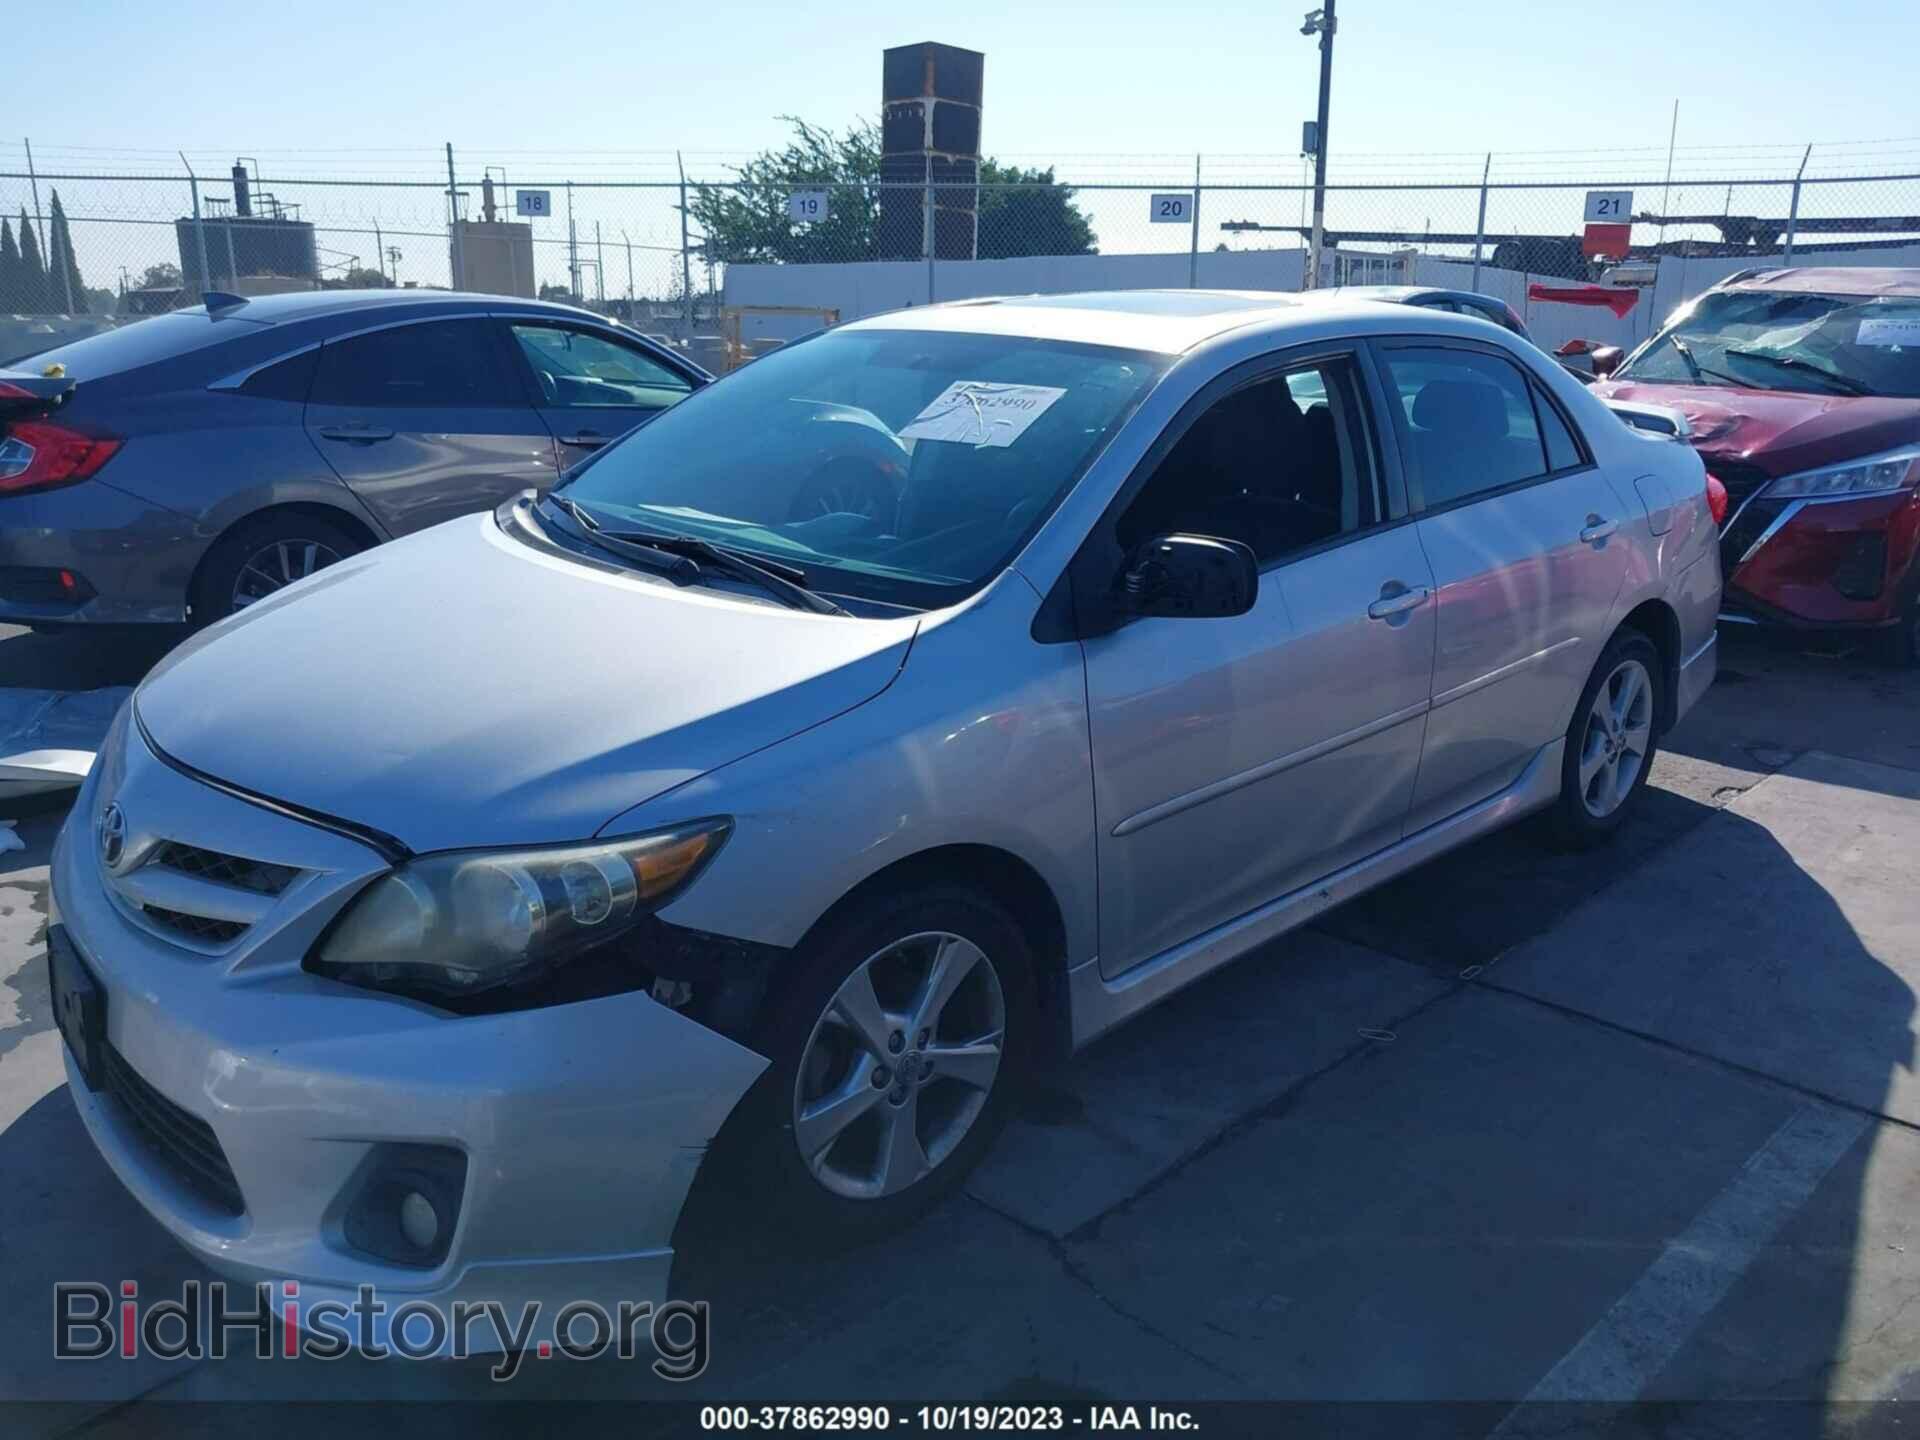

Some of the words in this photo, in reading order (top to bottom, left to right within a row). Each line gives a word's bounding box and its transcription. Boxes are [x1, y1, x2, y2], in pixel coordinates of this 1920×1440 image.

[524, 197, 542, 210] 18
[800, 200, 817, 214] 19
[1160, 200, 1182, 216] 20
[1598, 199, 1619, 214] 21
